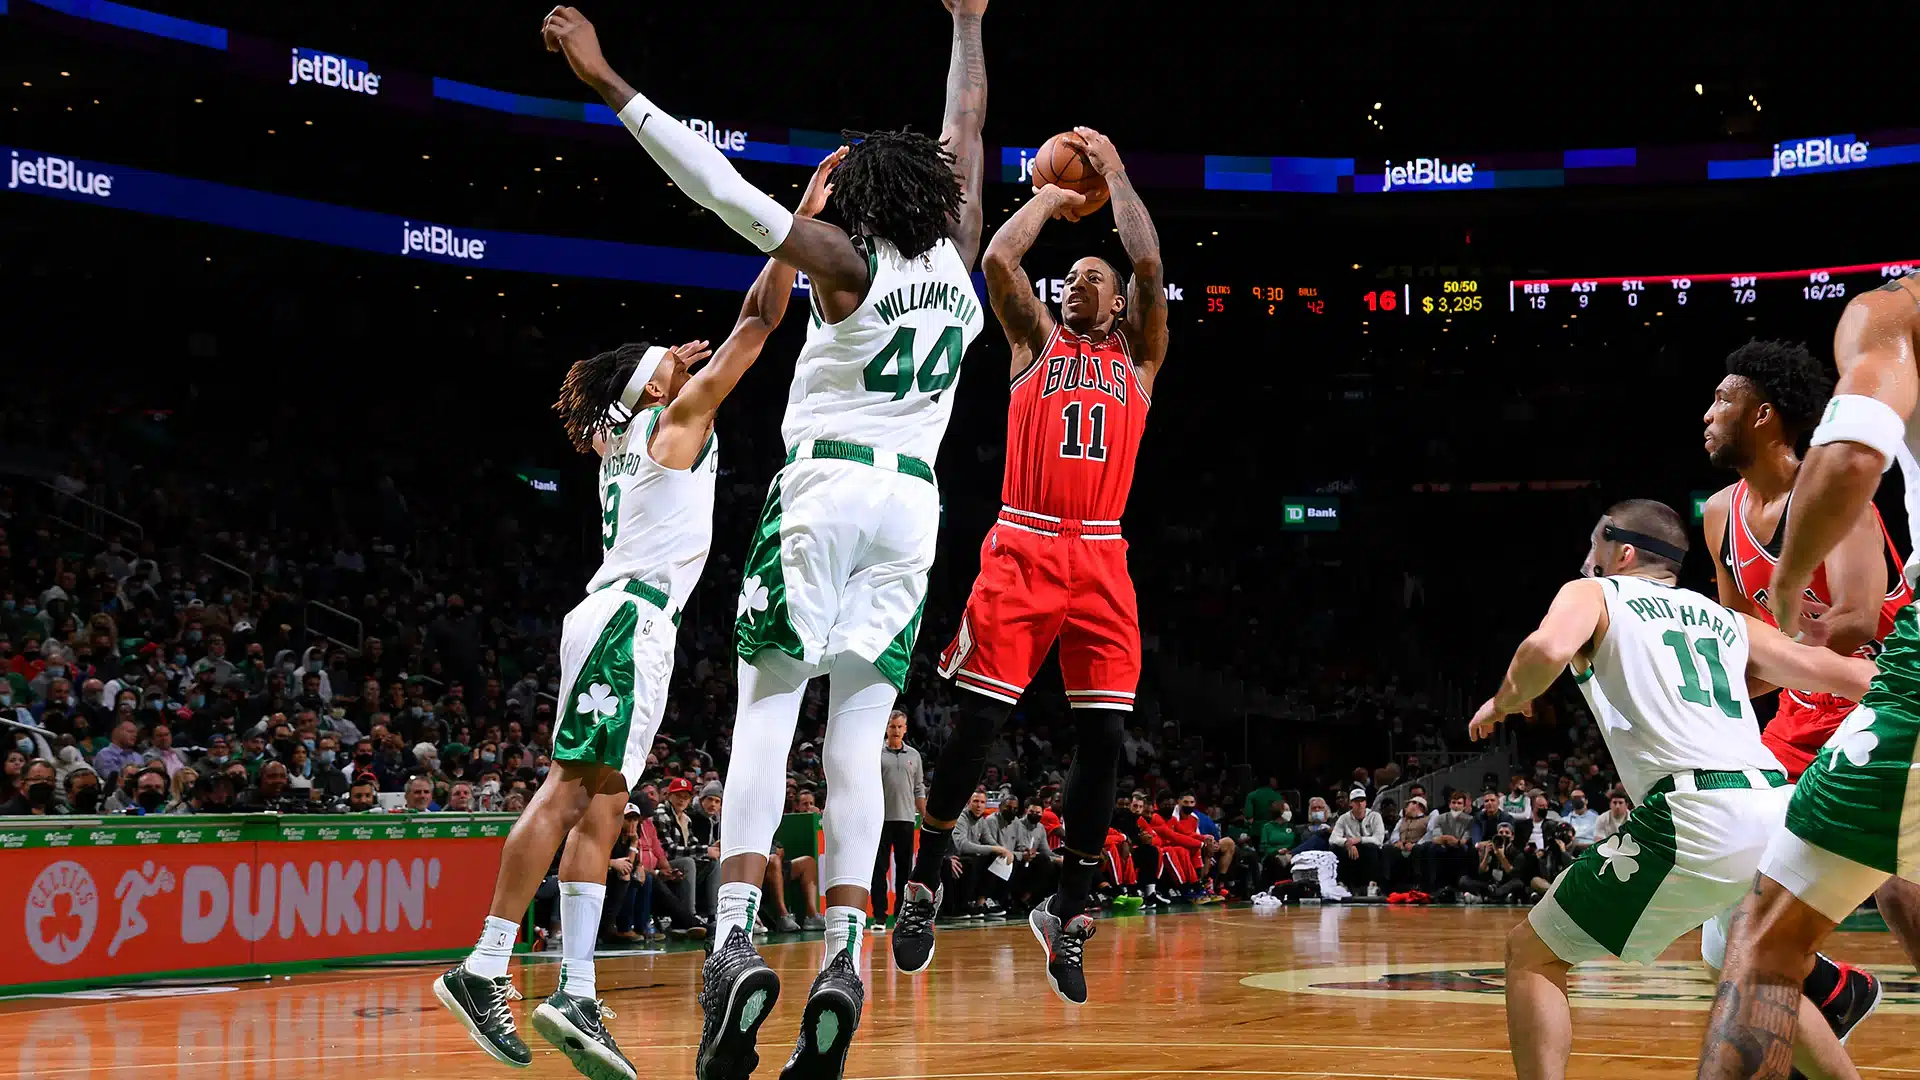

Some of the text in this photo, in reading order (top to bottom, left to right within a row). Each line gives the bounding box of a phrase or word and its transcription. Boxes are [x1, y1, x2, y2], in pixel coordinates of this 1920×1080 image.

[289, 48, 380, 95] jetBlue
[682, 118, 746, 151] Blue
[8, 150, 112, 197] jetBlue
[1771, 138, 1868, 177] jetBlue
[1382, 158, 1474, 192] jetBlue
[401, 221, 485, 260] jetBlue
[1206, 285, 1231, 295] CELTICS
[1252, 286, 1284, 301] 9:30
[1443, 281, 1478, 293] 50/50
[1524, 283, 1550, 294] REB
[1571, 282, 1598, 292] AST
[1622, 280, 1645, 291] STL
[1671, 278, 1691, 290] TO
[1730, 276, 1757, 288] 3PT
[1809, 271, 1830, 284] FG
[1529, 296, 1546, 309] 15
[1579, 294, 1589, 308] 9
[1677, 292, 1687, 305] 5
[1733, 289, 1756, 304] 7/9
[1802, 283, 1845, 300] 16/25
[1207, 297, 1225, 312] 35
[1307, 300, 1325, 314] 42
[1363, 290, 1397, 311] 16
[863, 325, 963, 404] 44
[1041, 352, 1126, 406] BULLS
[1059, 400, 1107, 462] 11
[1287, 507, 1337, 520] TD Bank
[1626, 596, 1737, 648] PRITHARD
[1662, 629, 1742, 719] 11
